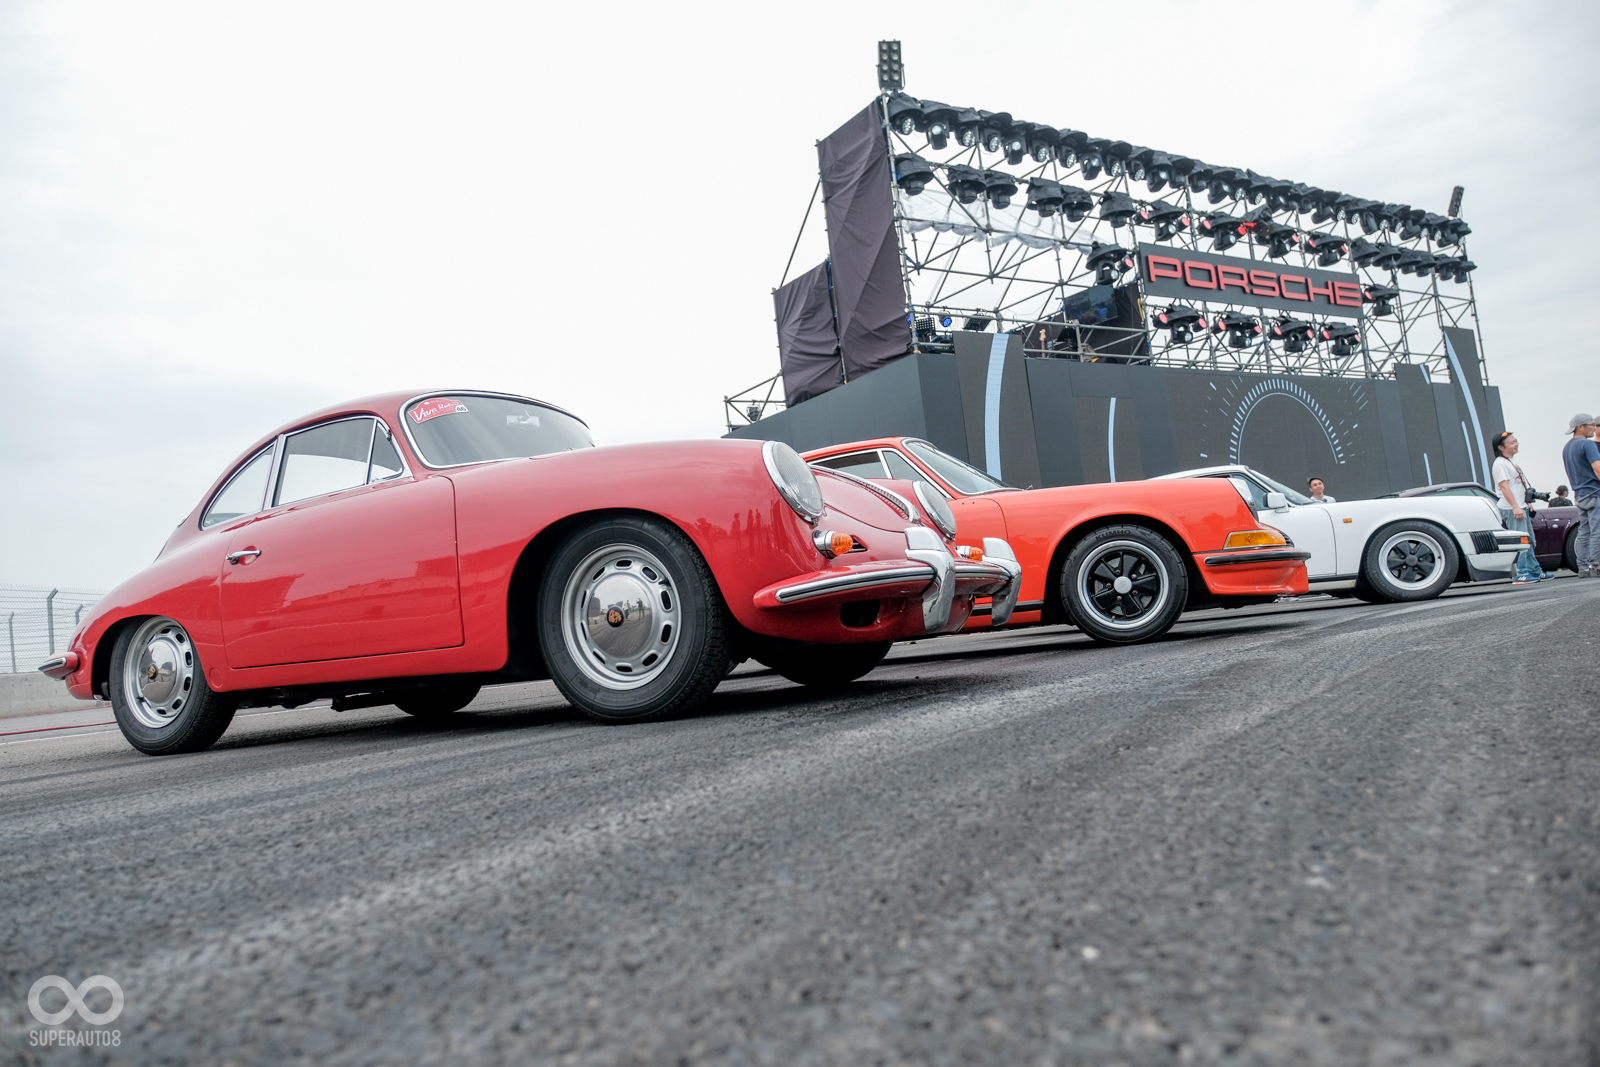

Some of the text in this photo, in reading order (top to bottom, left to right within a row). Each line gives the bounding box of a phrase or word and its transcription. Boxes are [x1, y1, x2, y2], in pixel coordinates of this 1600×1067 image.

[1147, 254, 1362, 307] PORSCHE
[413, 407, 437, 421] Viva
[1095, 530, 1131, 541] KUMHO
